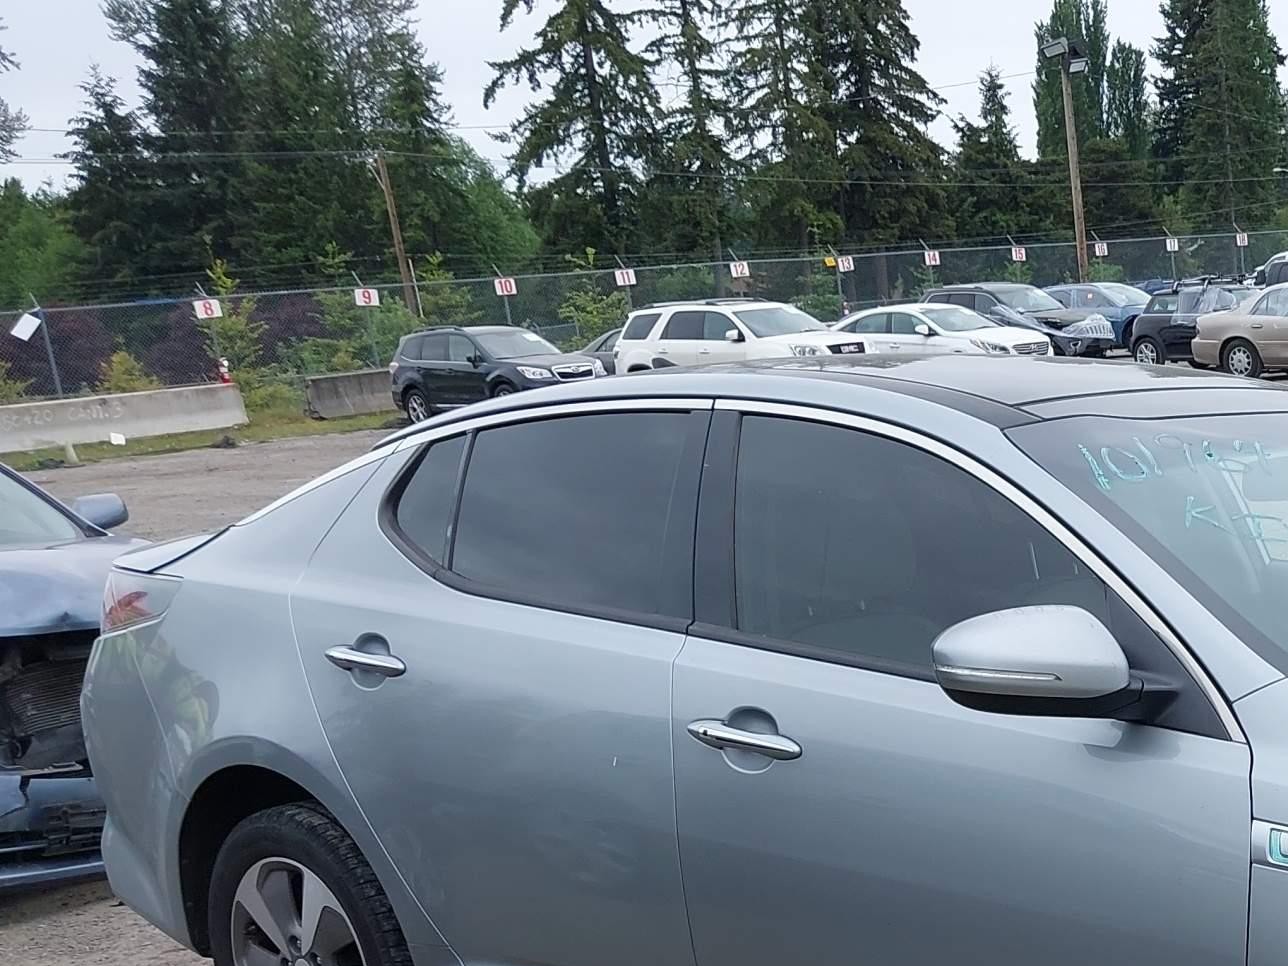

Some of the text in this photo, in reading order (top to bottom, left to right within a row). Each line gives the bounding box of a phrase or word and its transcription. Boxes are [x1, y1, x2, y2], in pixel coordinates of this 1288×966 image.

[928, 251, 938, 264] 14
[1014, 247, 1024, 260] 15
[732, 262, 747, 276] 12
[619, 271, 633, 284] 11
[497, 280, 514, 294] 10
[362, 290, 372, 304] 9
[203, 302, 214, 317] 8
